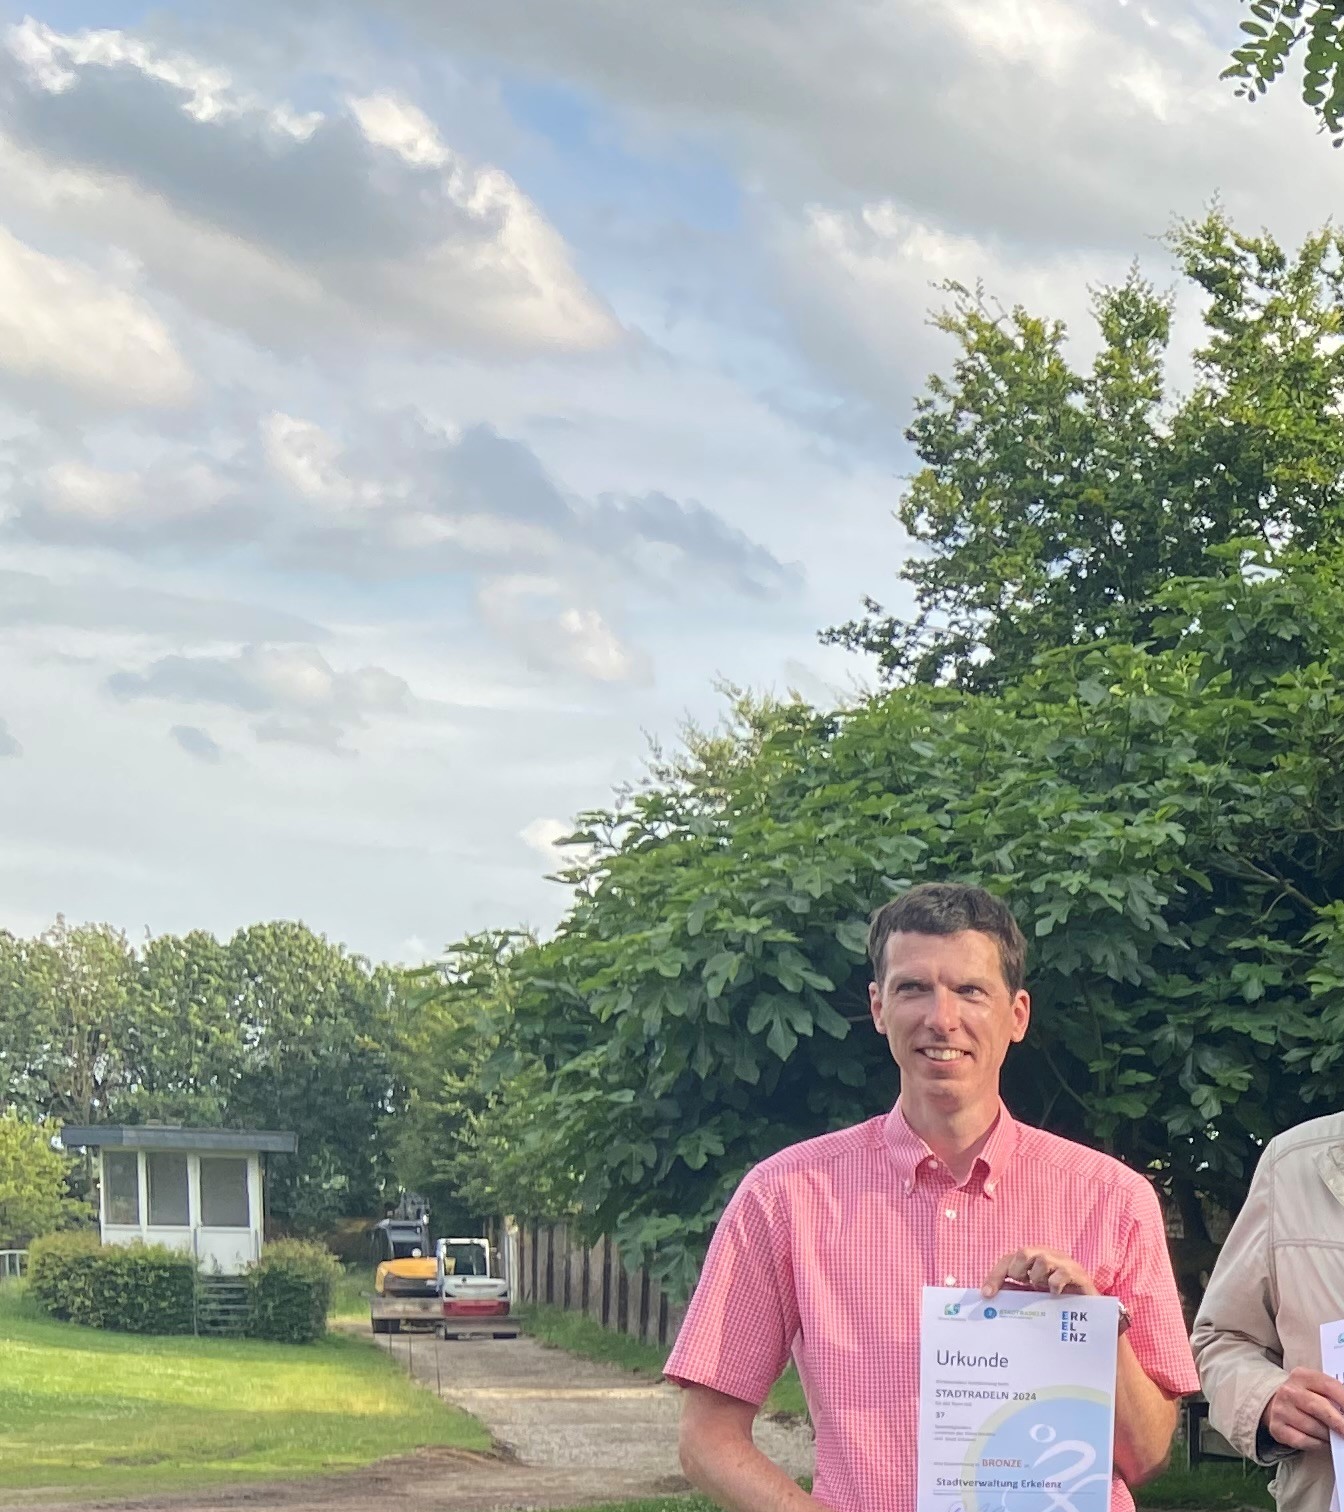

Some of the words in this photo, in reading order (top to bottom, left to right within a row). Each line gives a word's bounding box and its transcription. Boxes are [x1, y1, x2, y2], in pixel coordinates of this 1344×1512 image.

[1061, 1310, 1089, 1322] ERK
[1061, 1321, 1076, 1332] EL
[1060, 1332, 1087, 1343] ENZ
[936, 1349, 1009, 1369] Urkunde
[935, 1388, 1010, 1401] STADTRADELN
[1012, 1391, 1038, 1401] 2024
[981, 1458, 1023, 1468] BRONZE
[935, 1477, 1019, 1490] Stadtverwaltung
[1020, 1479, 1063, 1490] Erkelenz
